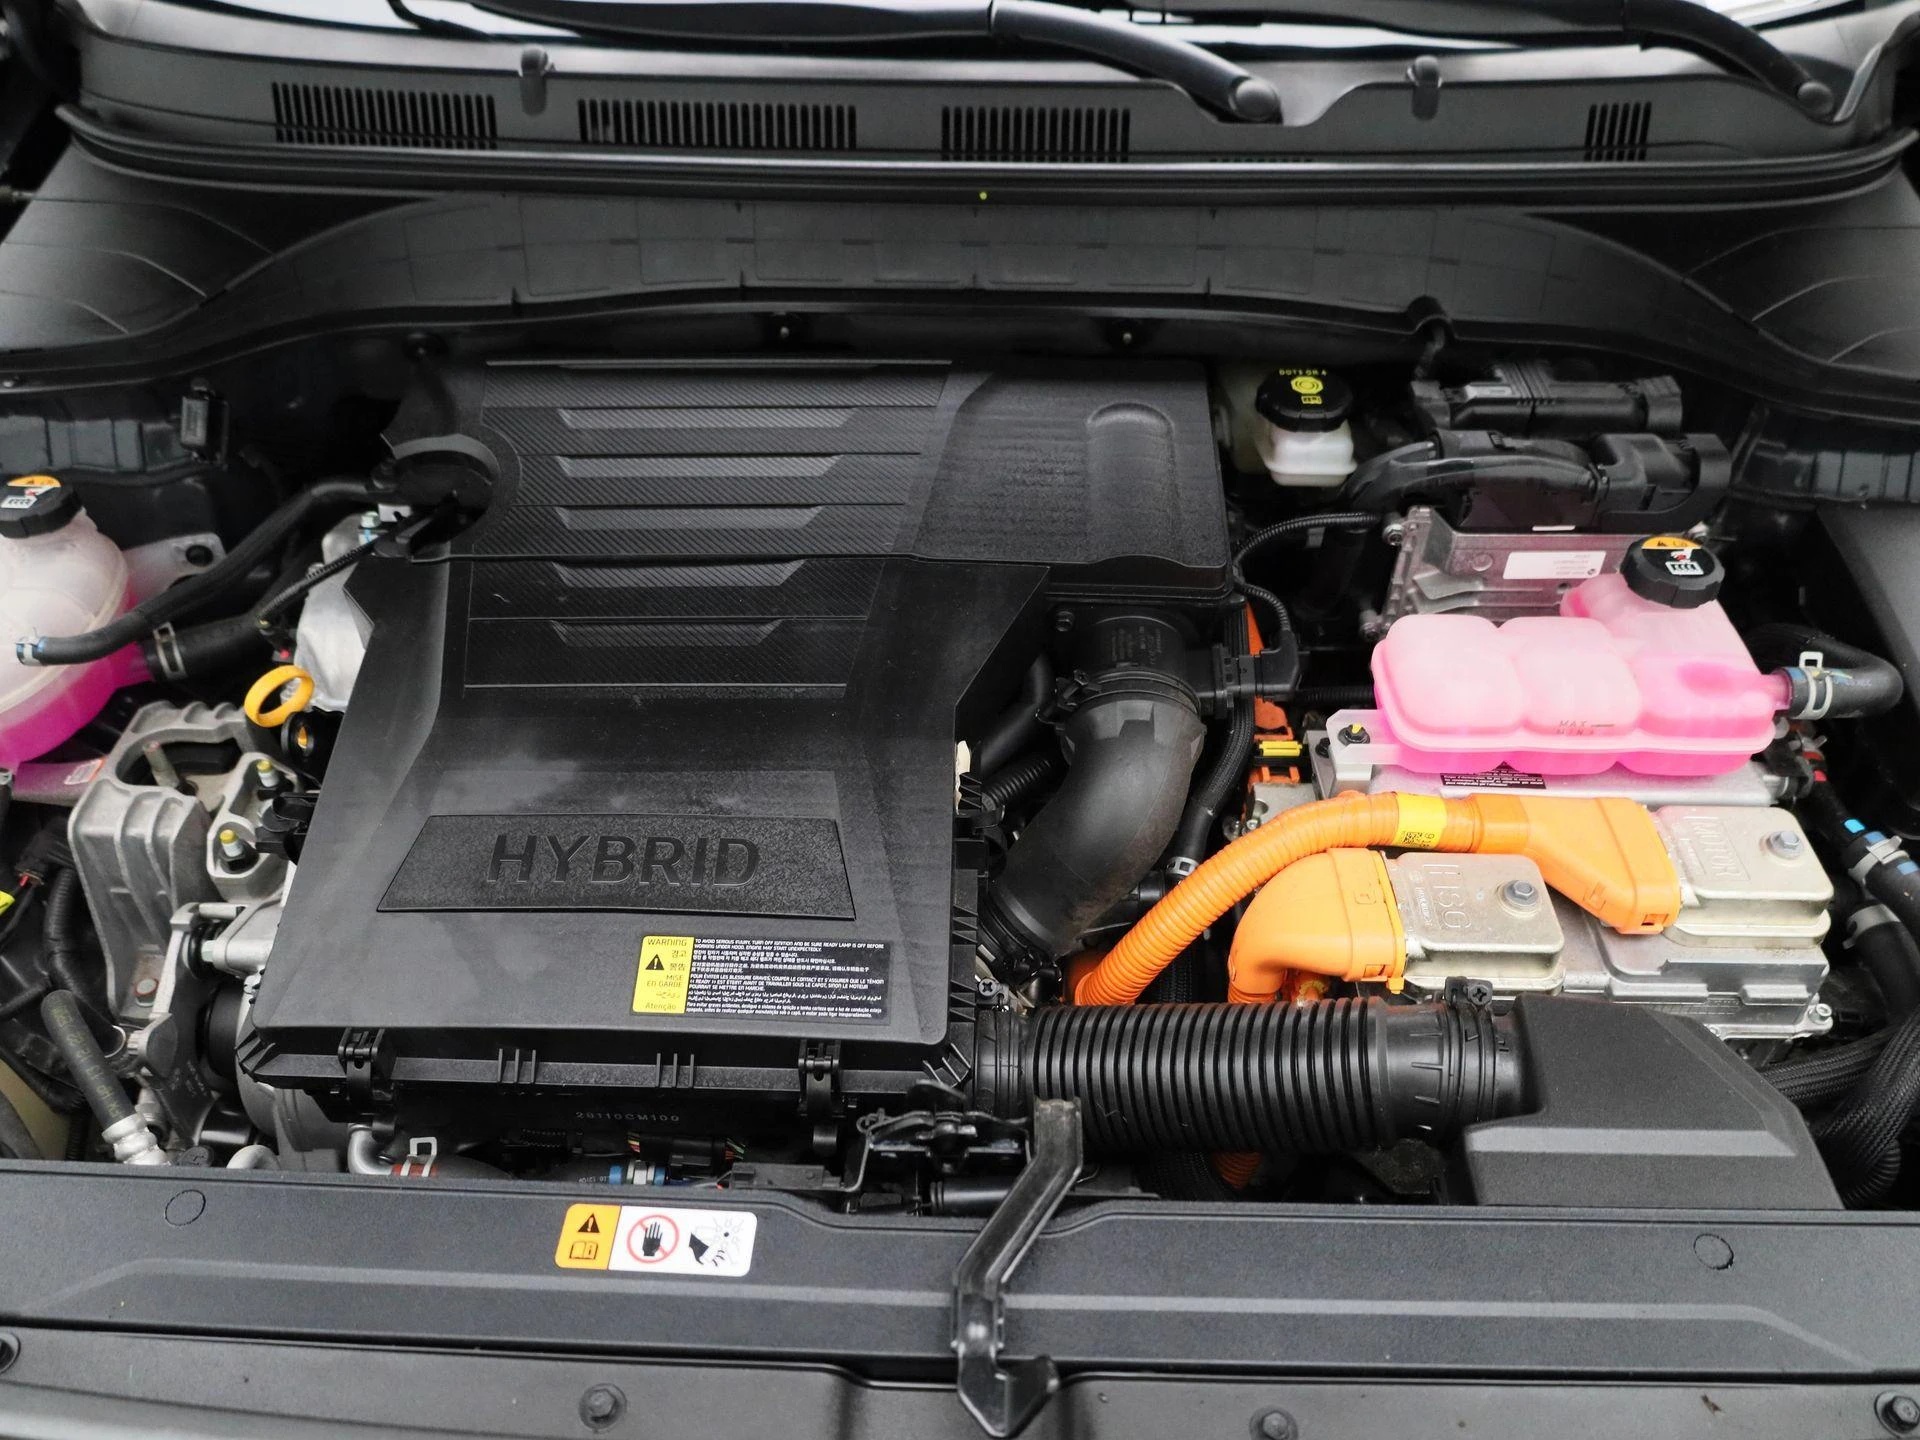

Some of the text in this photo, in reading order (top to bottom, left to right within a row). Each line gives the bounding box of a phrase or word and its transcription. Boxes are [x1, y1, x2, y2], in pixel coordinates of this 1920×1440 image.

[486, 833, 761, 888] HYBRID
[1691, 822, 1741, 879] MOTOR
[648, 938, 687, 946] WARNING
[645, 1002, 676, 1011] Atenção
